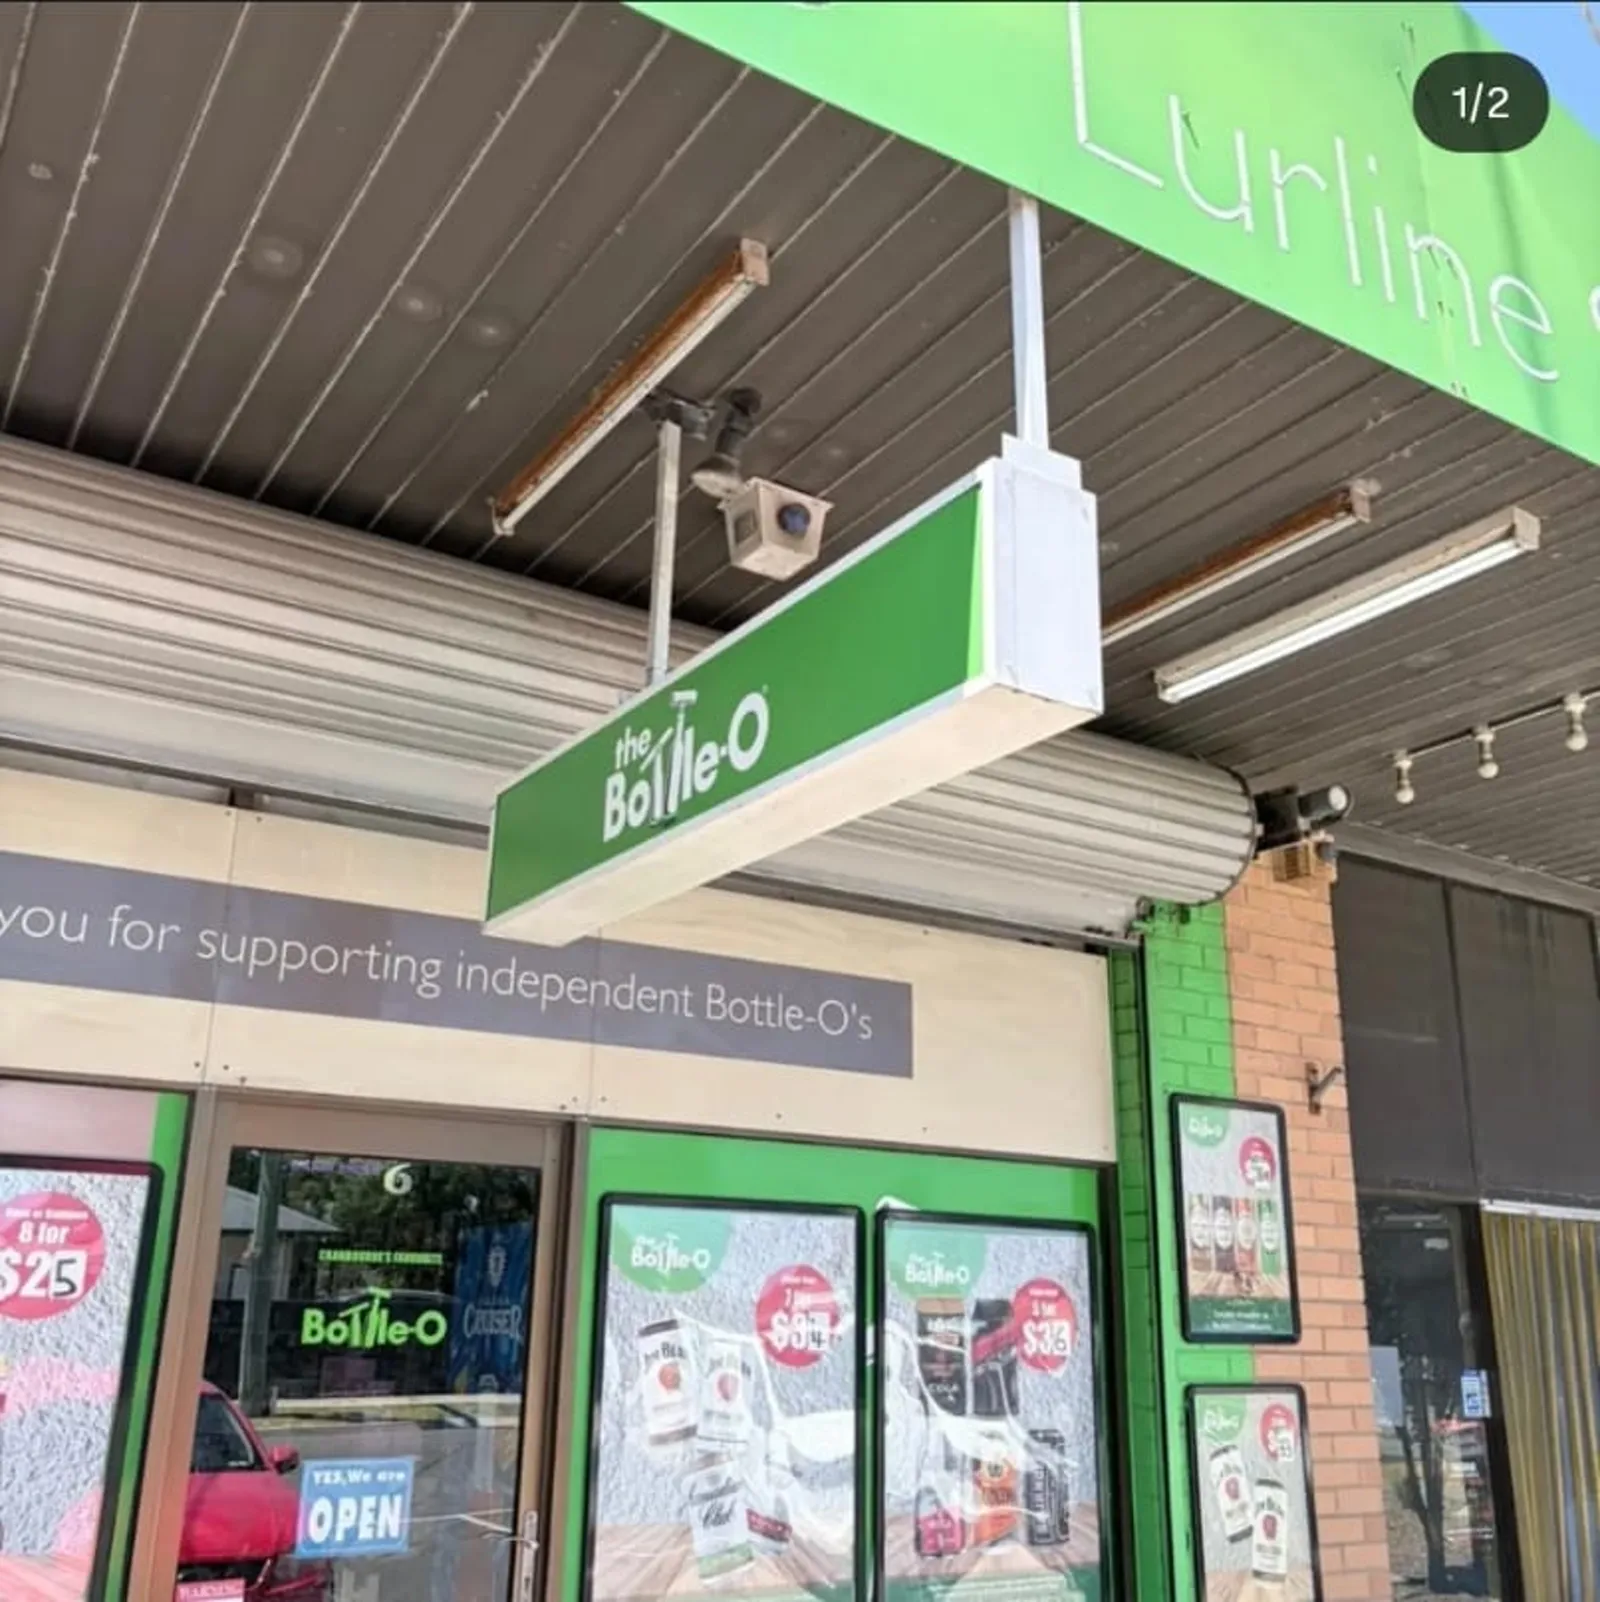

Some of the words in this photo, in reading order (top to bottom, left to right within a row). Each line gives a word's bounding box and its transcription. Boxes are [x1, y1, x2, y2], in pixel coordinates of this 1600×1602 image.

[1068, 2, 1560, 381] Lurline
[615, 726, 652, 769] the
[0, 904, 87, 943] you
[108, 904, 181, 953] for
[196, 929, 443, 999] supporting
[456, 950, 694, 1018] independent
[706, 984, 873, 1040] Bottle-O's
[384, 1164, 413, 1195] 6
[19, 1220, 34, 1244] 8
[38, 1222, 70, 1245] for
[308, 1494, 403, 1543] OPEN
